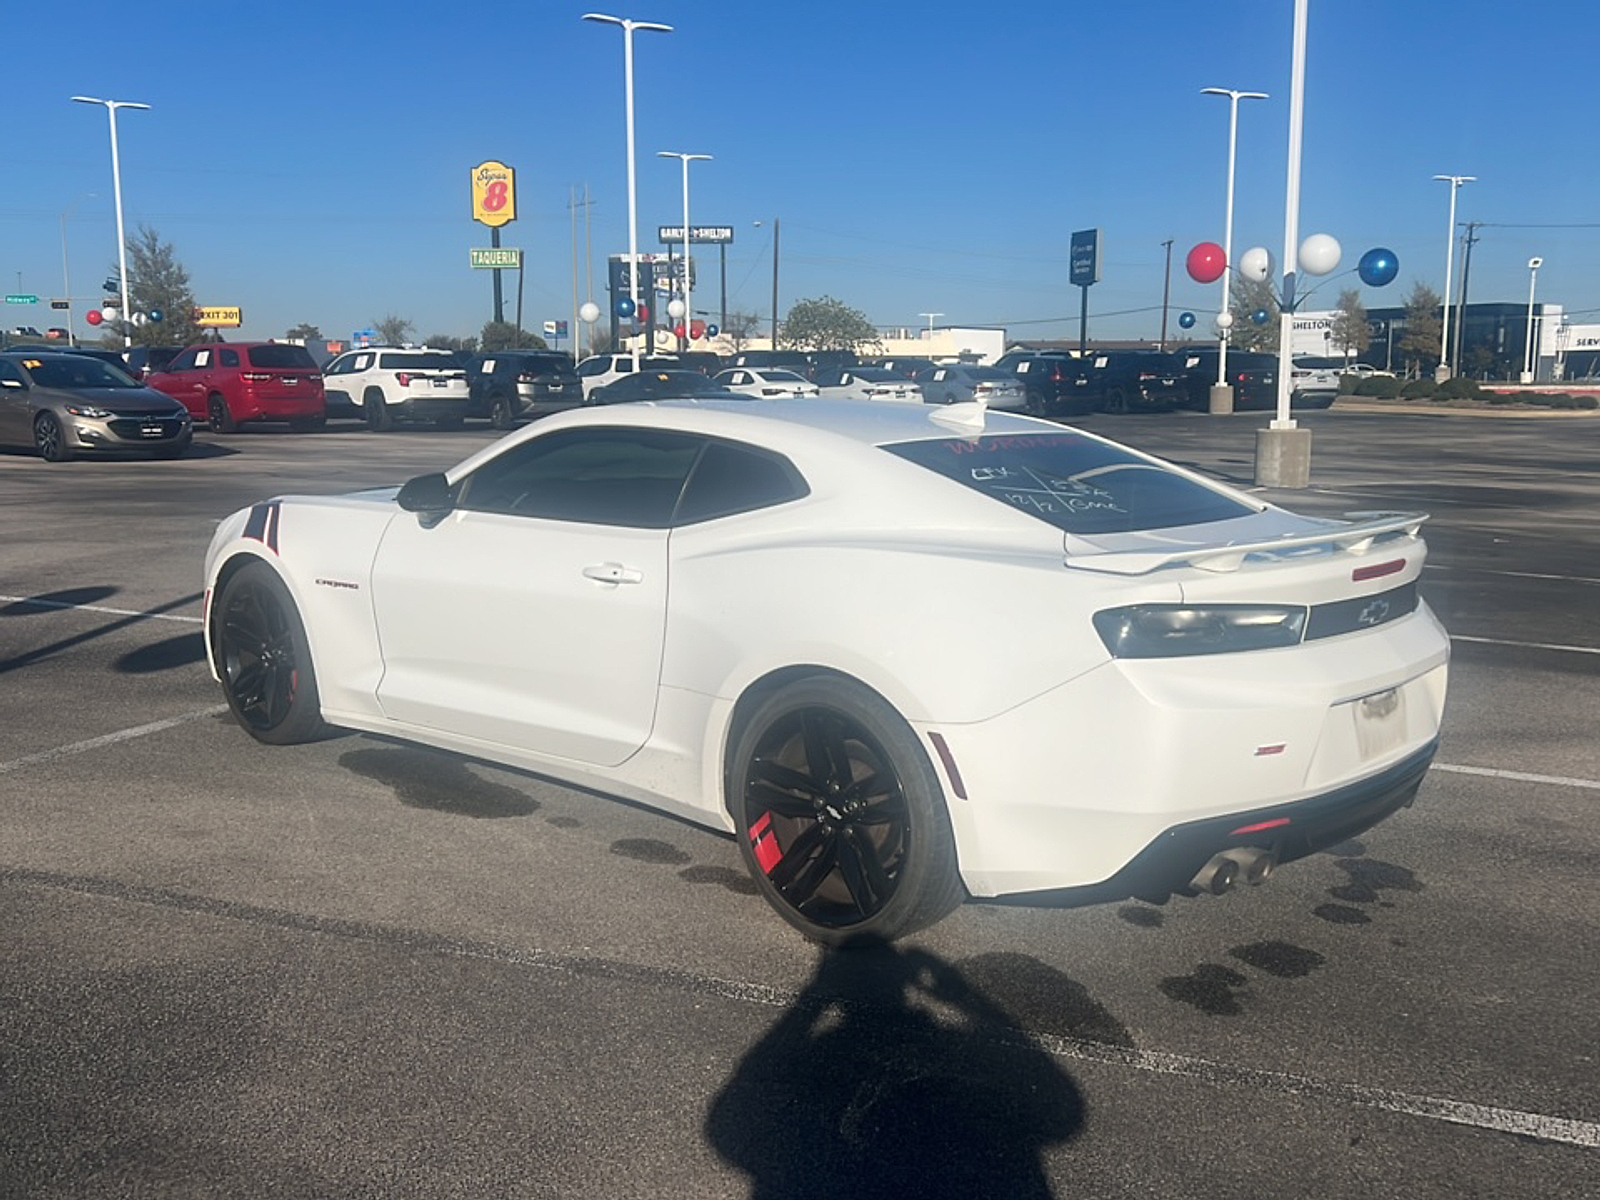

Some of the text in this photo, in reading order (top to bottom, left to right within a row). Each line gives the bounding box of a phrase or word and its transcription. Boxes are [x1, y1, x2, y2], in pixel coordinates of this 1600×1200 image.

[481, 181, 508, 212] 8
[472, 251, 518, 265] TAQUERIA
[222, 311, 238, 320] 301
